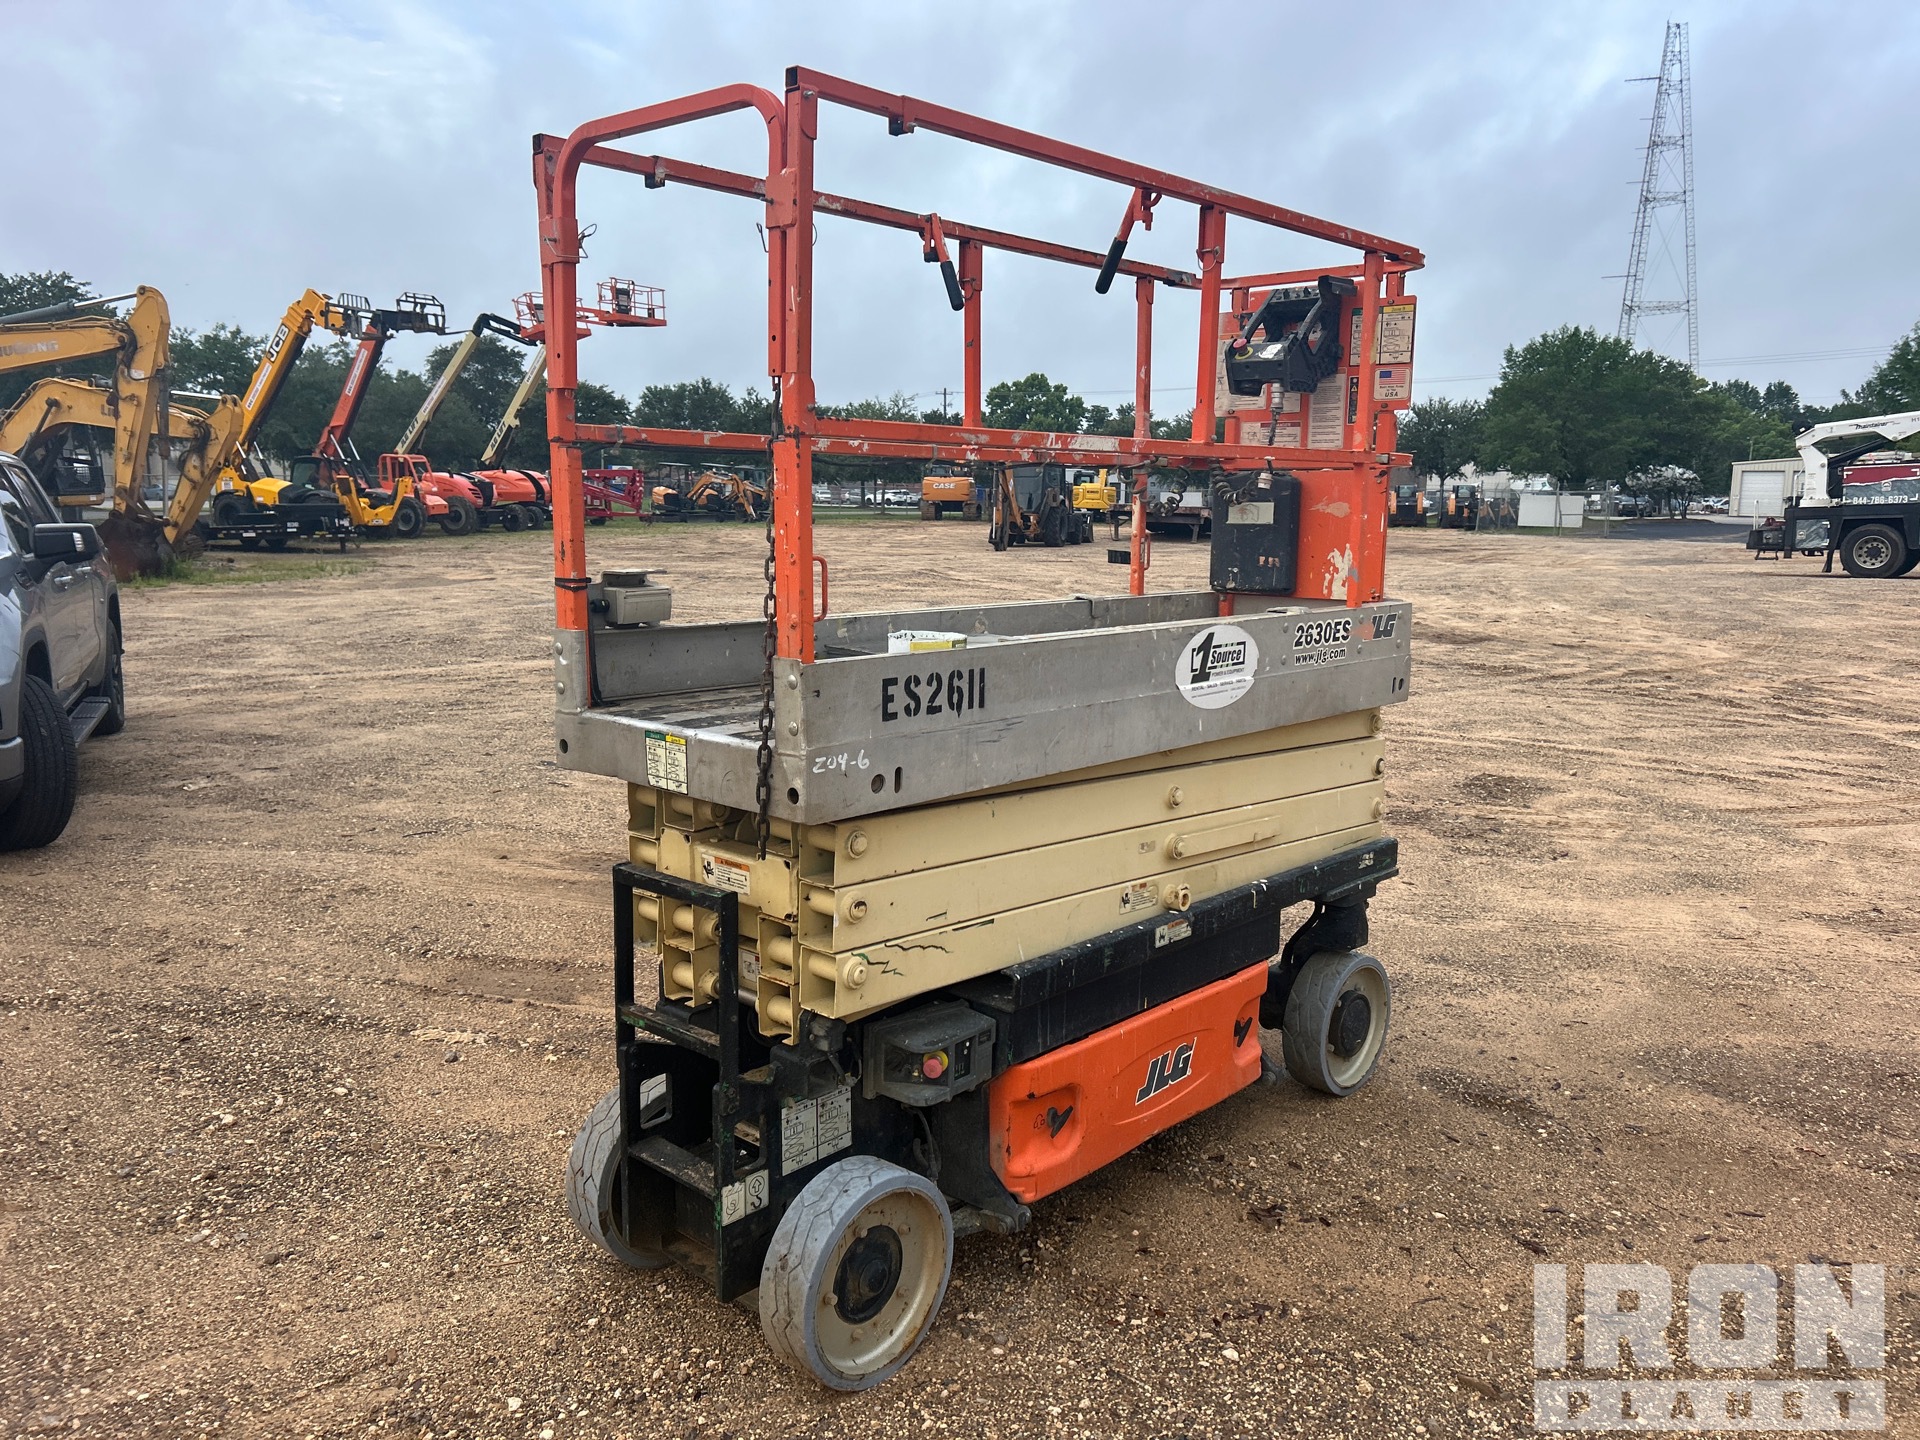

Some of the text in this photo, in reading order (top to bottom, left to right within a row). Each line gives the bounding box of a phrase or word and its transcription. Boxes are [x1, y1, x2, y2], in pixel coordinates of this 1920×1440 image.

[268, 324, 289, 362] JCB
[409, 416, 419, 435] LIFT
[497, 421, 507, 438] LIFT
[1293, 619, 1352, 649] 2630ES
[1190, 631, 1242, 685] 1 Source
[1294, 647, 1347, 665] www.jlg.com
[881, 667, 986, 722] ES2611
[1134, 1036, 1198, 1106] JLG
